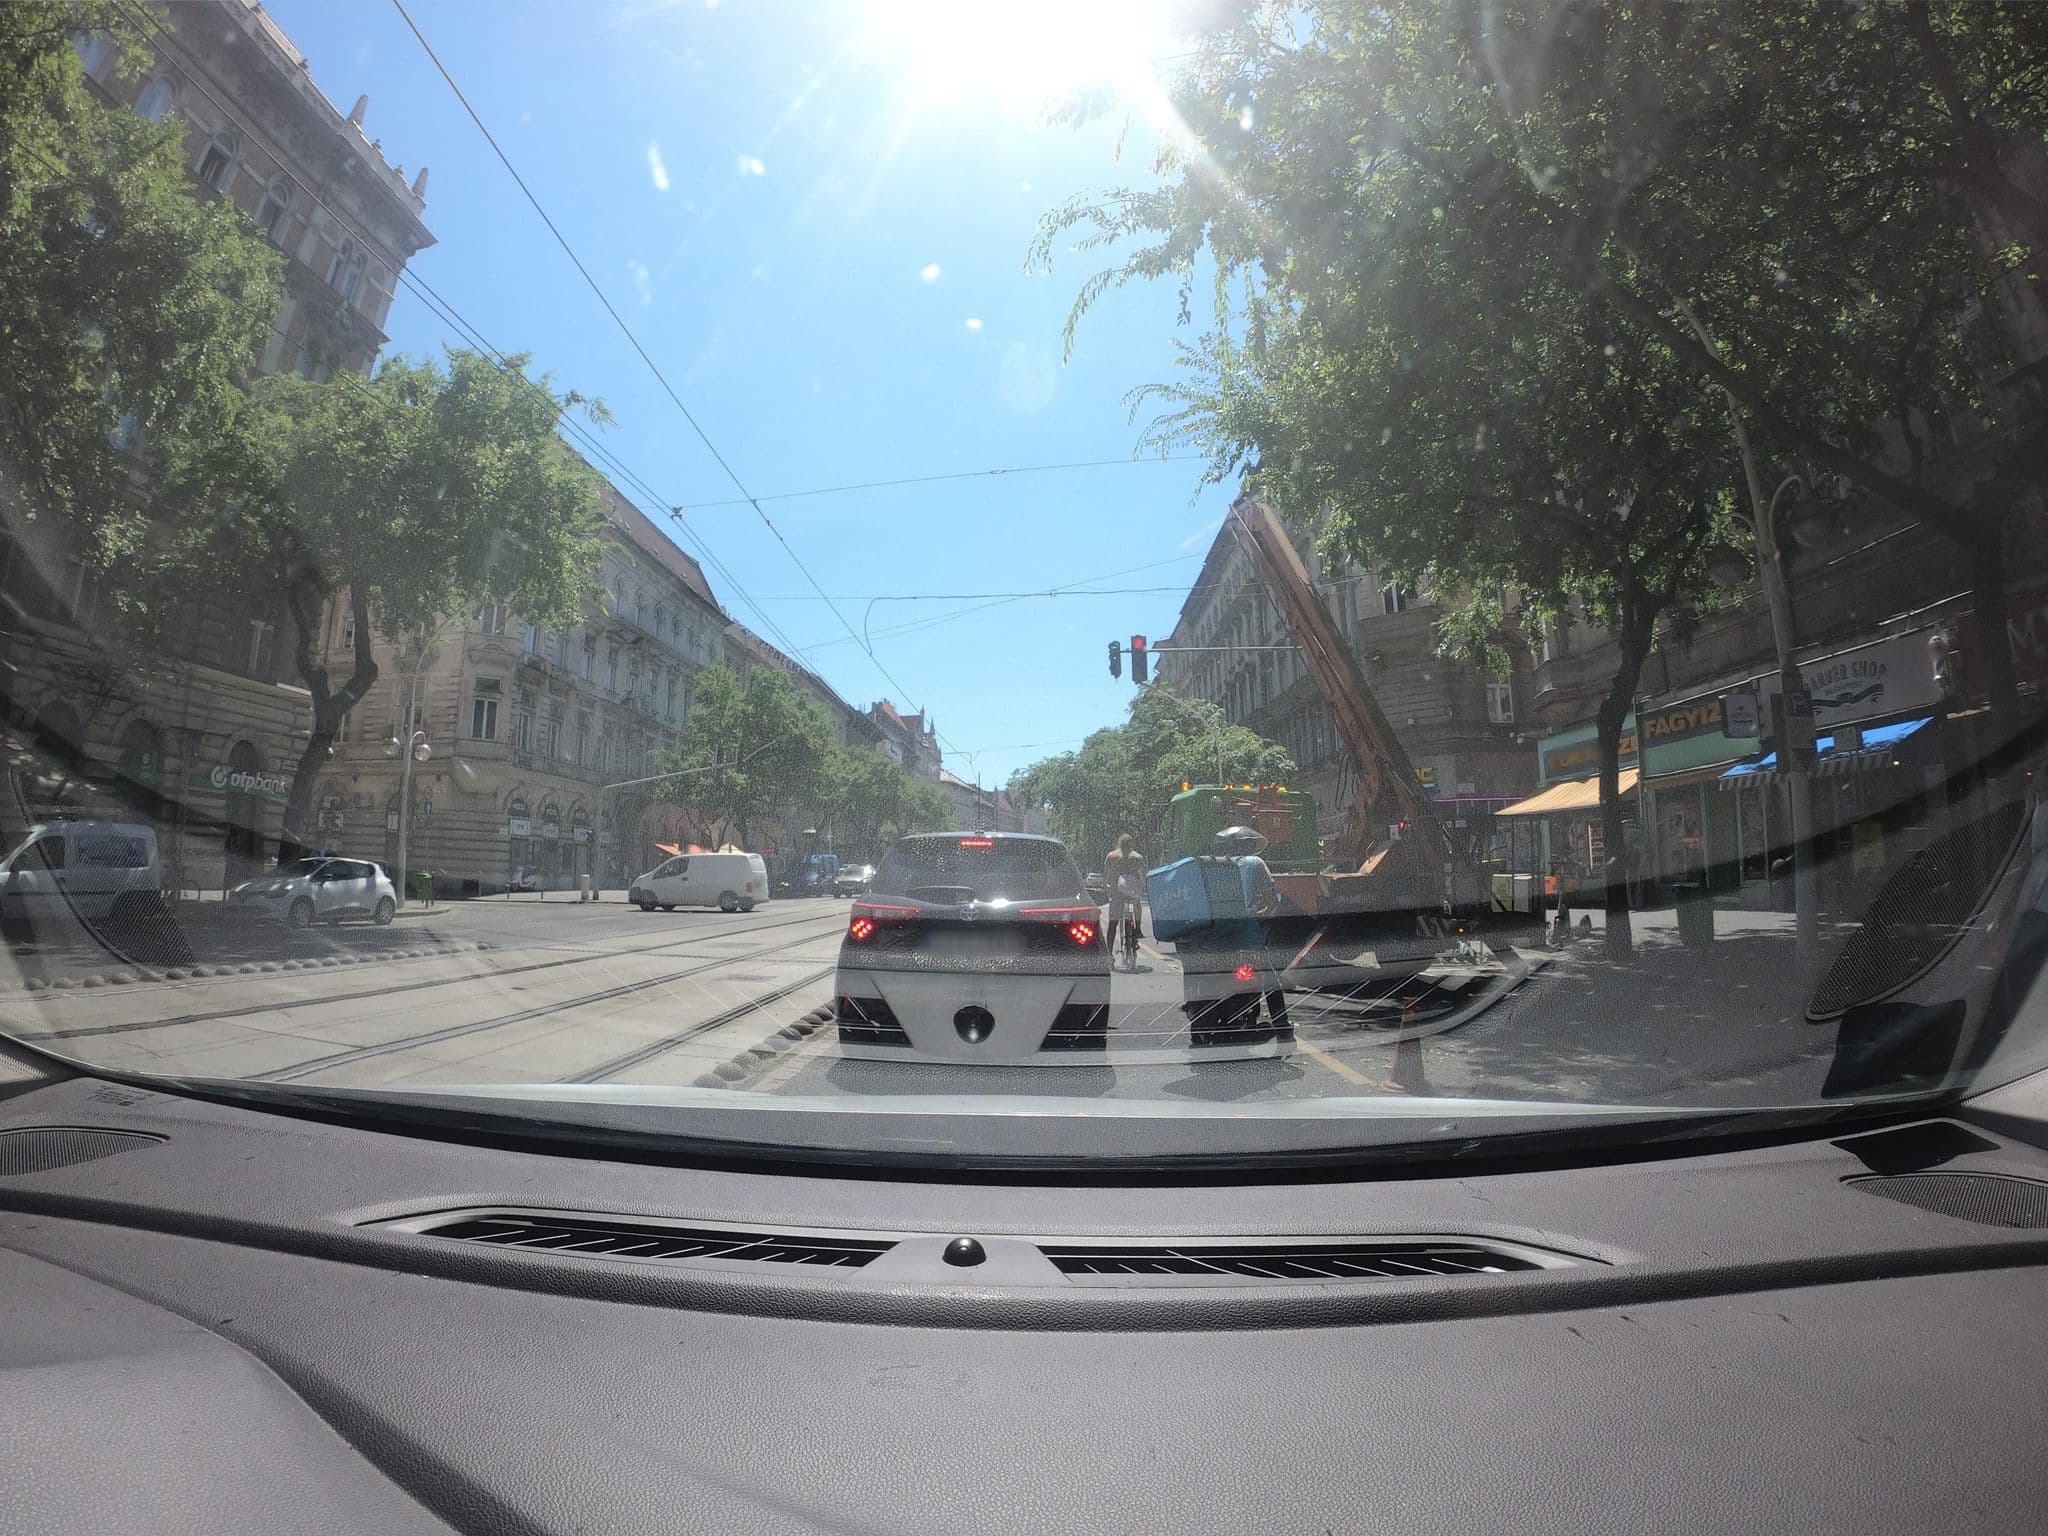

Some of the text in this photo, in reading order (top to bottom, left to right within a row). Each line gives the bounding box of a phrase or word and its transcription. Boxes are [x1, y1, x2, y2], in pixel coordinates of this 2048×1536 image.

[1851, 660, 1887, 680] SHOP
[1644, 702, 1722, 737] FAGYIZ
[231, 772, 286, 793] otpbank
